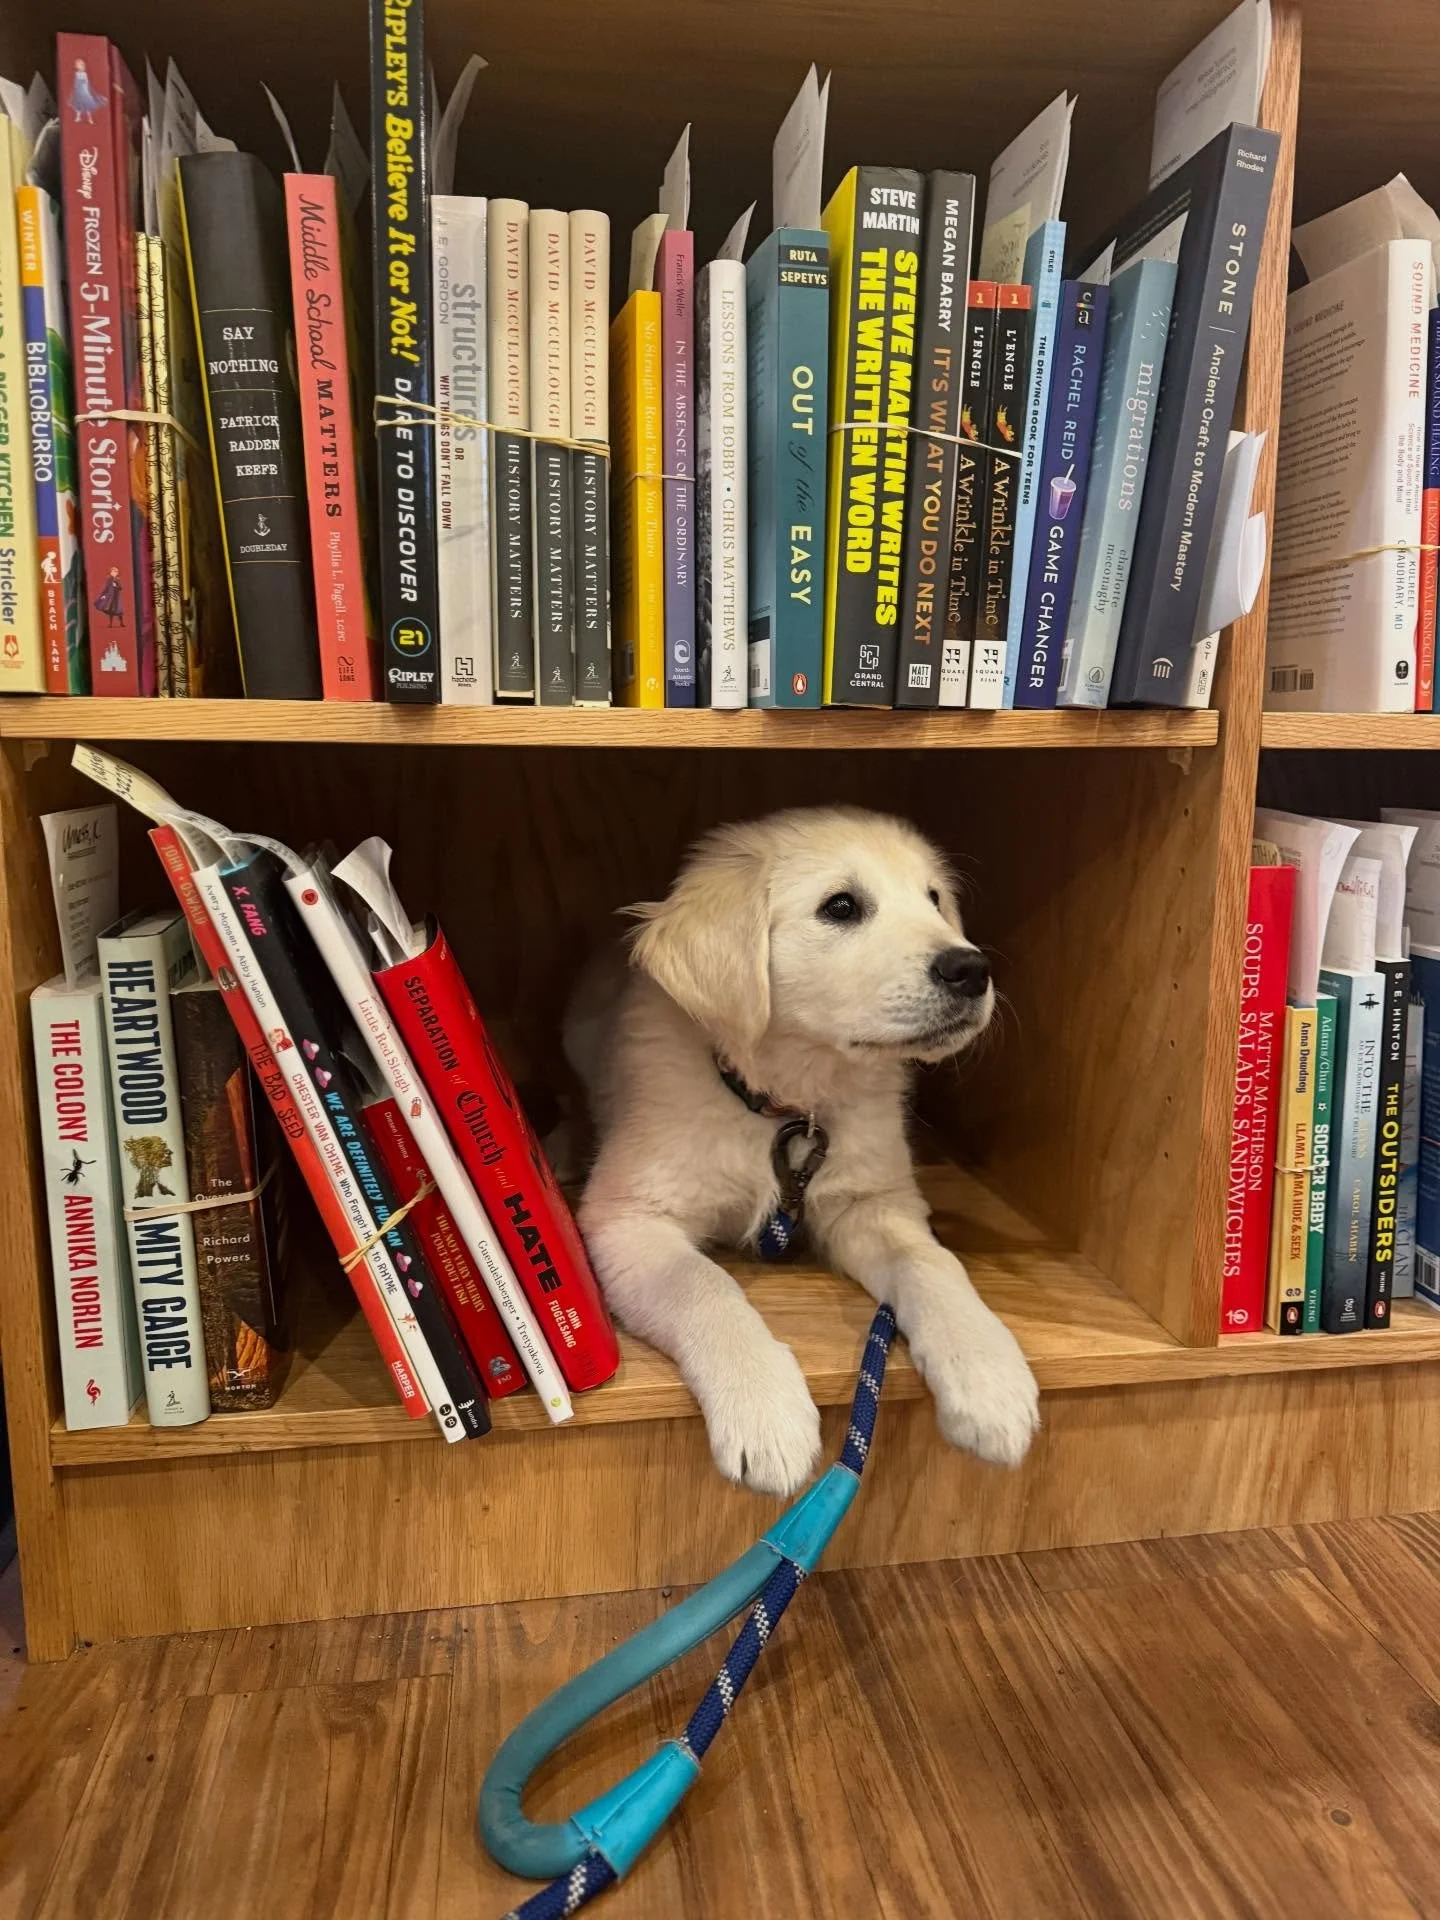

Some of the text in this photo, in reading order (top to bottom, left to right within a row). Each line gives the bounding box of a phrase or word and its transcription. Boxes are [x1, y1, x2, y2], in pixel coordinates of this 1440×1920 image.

[1235, 159, 1265, 173] Rhodes
[1237, 148, 1267, 162] Richard
[385, 113, 421, 364] Believe It or Not!
[862, 211, 920, 236] MARTIN
[869, 187, 917, 210] STEVE
[24, 208, 38, 272] WINTER
[506, 222, 519, 280] DAVID
[548, 232, 560, 291] DAVID
[584, 232, 596, 290] DAVID
[780, 271, 828, 286] SEPETYS
[789, 249, 818, 263] RUTA
[438, 256, 449, 325] GORDON
[676, 254, 686, 318] Francis Weller
[79, 147, 122, 544] Disney FROZEN 5-Minute Stories
[208, 358, 280, 376] NOTHING
[222, 326, 255, 341] SAY
[299, 193, 343, 518] Middle School MATTERS
[1408, 261, 1424, 399] SOUND MEDICINE
[26, 341, 53, 482] BIBLIOBURRO
[845, 247, 888, 573] THE WRITTEN WORD
[1022, 250, 1056, 505] STILES THE DRIVING BOOK FOR TEENS
[1060, 343, 1087, 460] RACHEL REID
[1169, 222, 1247, 592] STONE Ancient Craft Modern Mastery
[219, 415, 280, 429] PATRICK
[229, 439, 281, 453] RADDEN
[440, 375, 452, 530] WHY FALL DOWN
[455, 447, 465, 461] OR
[875, 249, 919, 626] STEVE MARTIN WRITES
[913, 198, 959, 646] MEGAN BARRY IT'S WHAT YOU DO NEXT
[1118, 360, 1155, 512] migrations
[235, 463, 279, 477] KEEFE
[394, 377, 417, 602] DARE TO DISCOVER
[675, 340, 688, 592] IN THE ABSENCE THE ORDINARY
[722, 288, 735, 651] LESSONS FROM BOBBY CHRIS MATTHEWS
[790, 365, 814, 605] OUT EASY
[0, 453, 18, 625] KITCHEN Strickler
[239, 543, 288, 555] DOUBLEDAY
[509, 533, 522, 619] MATTERS
[948, 473, 977, 623] Wrinkle Time
[985, 476, 1012, 625] Wrinkle Time
[1095, 543, 1116, 614] mcconaghy
[1111, 549, 1129, 608] charlotte
[549, 547, 563, 633] MATTERS
[585, 545, 598, 630] MATTERS
[1028, 525, 1064, 689] GAME CHANGER
[1394, 539, 1407, 630] CHAUDHARY, MD
[47, 590, 60, 672] BEACH LANE
[911, 665, 929, 676] MATT
[849, 679, 885, 688] CENTRAL
[854, 672, 882, 680] GRAND
[910, 676, 928, 686] HOLT
[179, 883, 209, 926] OSWALD
[240, 902, 268, 937] FANG
[220, 911, 267, 1009] Monsen Abby Hanlon
[376, 1030, 393, 1058] Red
[1318, 1015, 1333, 1092] Adams/Chua
[1363, 1040, 1376, 1079] INTO
[1389, 1007, 1403, 1061] HINTON
[404, 975, 563, 1294] SEPARATION Church HATE
[1248, 1011, 1274, 1191] MATTY MATHESON
[1289, 1022, 1311, 1260] Anna Dewdney LLAMA HIDE SEEK
[1386, 1083, 1400, 1117] THE
[49, 1019, 104, 1350] THE COLONY ANNIKA NORLIN
[107, 959, 193, 1372] HEARTWOOD GAIGE
[210, 1178, 233, 1188] The
[291, 1073, 398, 1296] CHESTER CHIME RHYME
[325, 1091, 385, 1202] WE ARE DEFINITELY
[1223, 1119, 1250, 1277] SANDWICHES
[1308, 1123, 1330, 1323] SOCCER BABY VIKING
[1375, 1121, 1400, 1263] OUTSIDERS
[203, 1233, 251, 1247] Richard
[206, 1253, 251, 1265] Powers
[278, 1106, 416, 1399] SEED HARPER
[1348, 1219, 1359, 1263] SHABEN
[477, 1239, 546, 1376] Guendelsberger Tretyakova
[547, 1299, 577, 1349] FUGELSANG
[565, 1306, 583, 1331] JOHN
